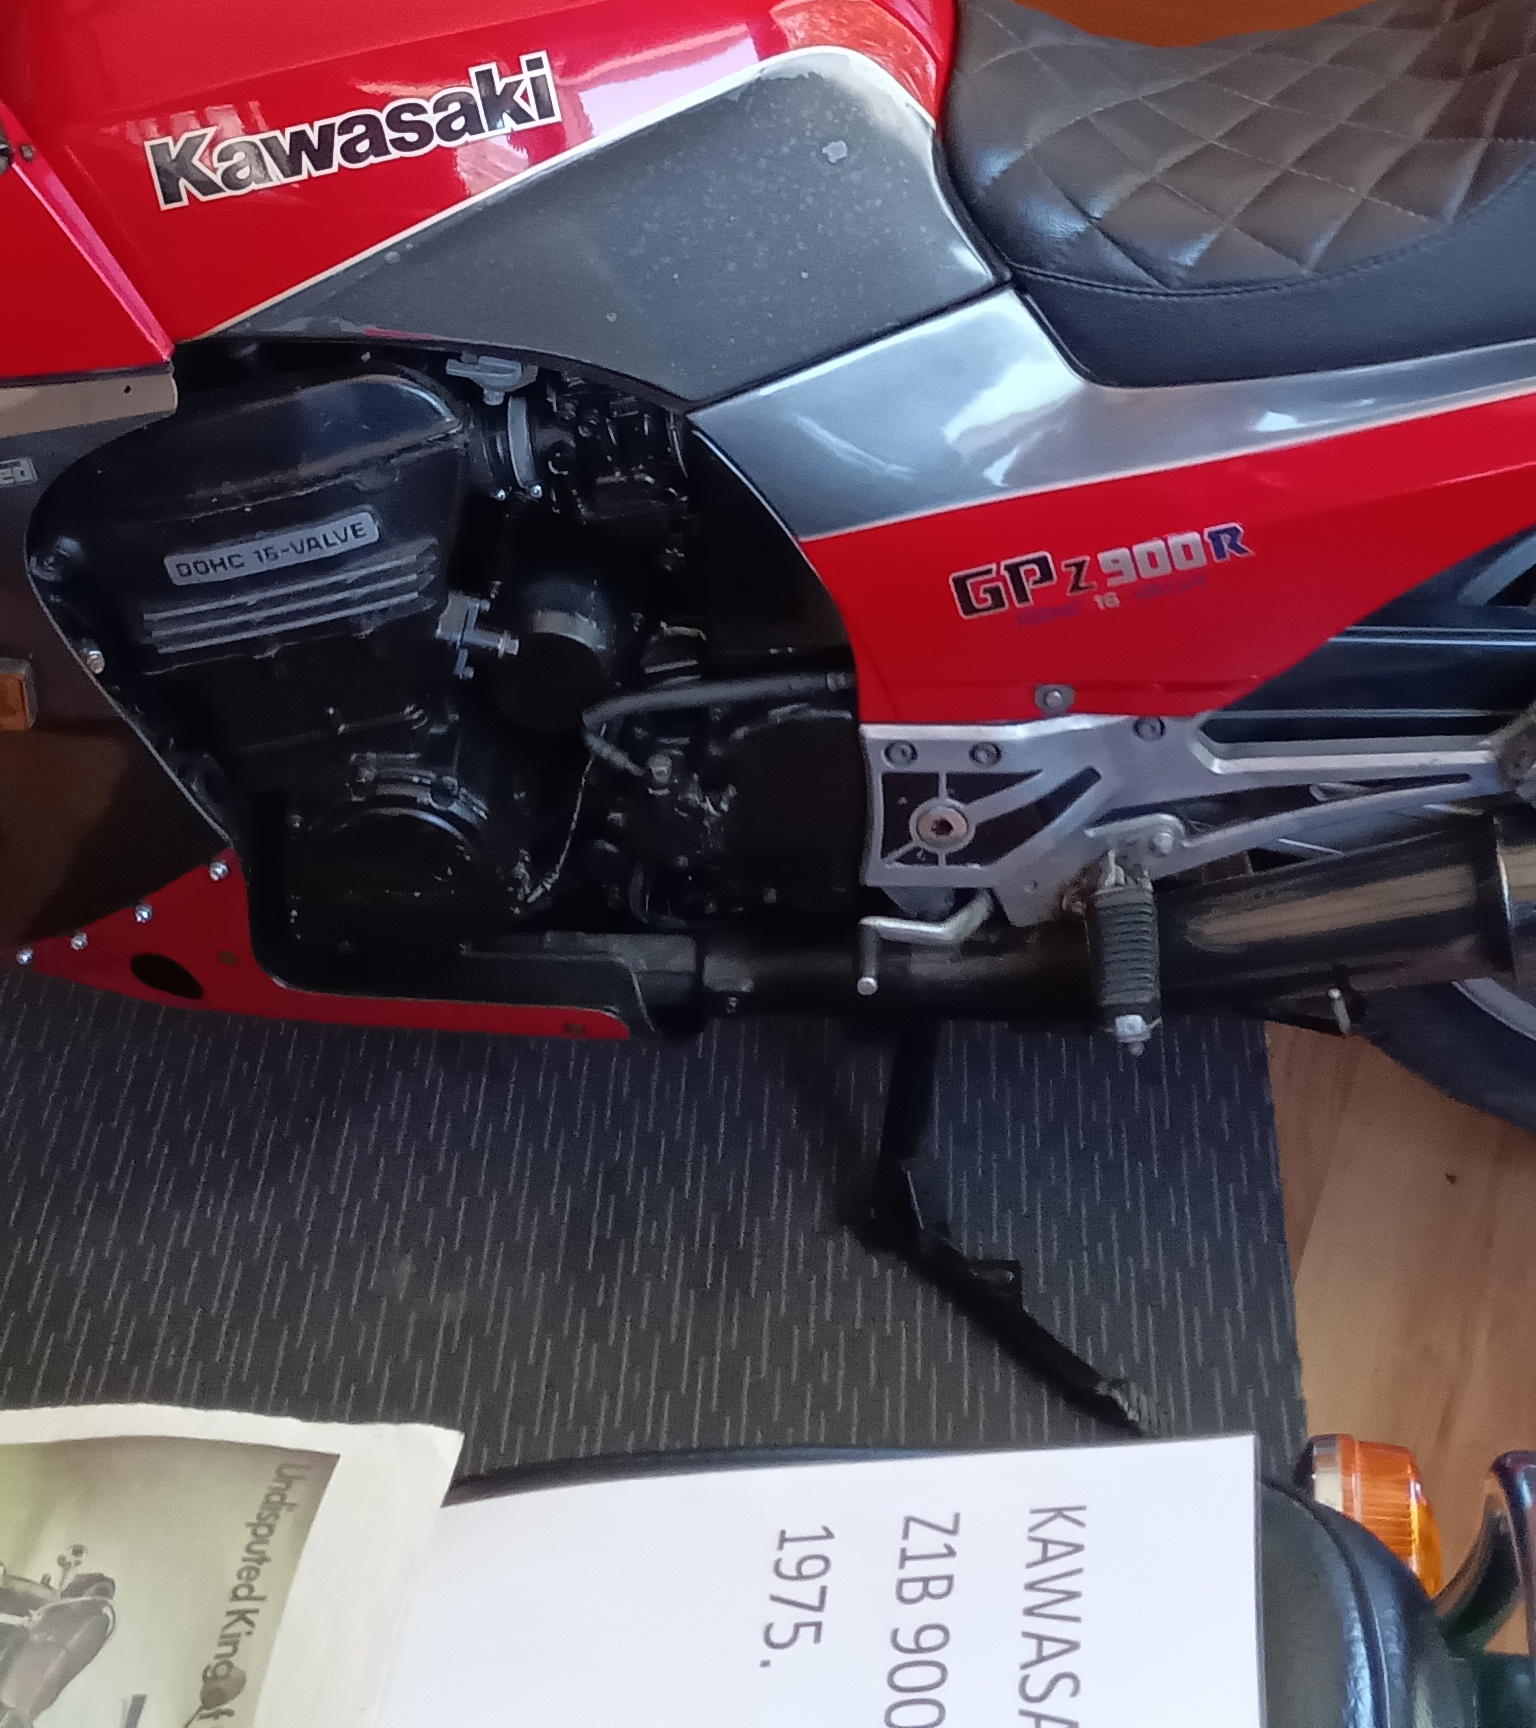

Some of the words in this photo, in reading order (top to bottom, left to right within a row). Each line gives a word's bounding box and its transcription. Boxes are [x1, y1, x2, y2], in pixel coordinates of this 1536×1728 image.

[142, 50, 562, 212] Kawasaki
[175, 553, 245, 578] DOHC
[228, 1461, 313, 1603] Undisputed
[894, 1511, 961, 1606] Z1B
[201, 1607, 261, 1684] King
[759, 1524, 836, 1669] 1975.
[883, 1622, 951, 1728] 900
